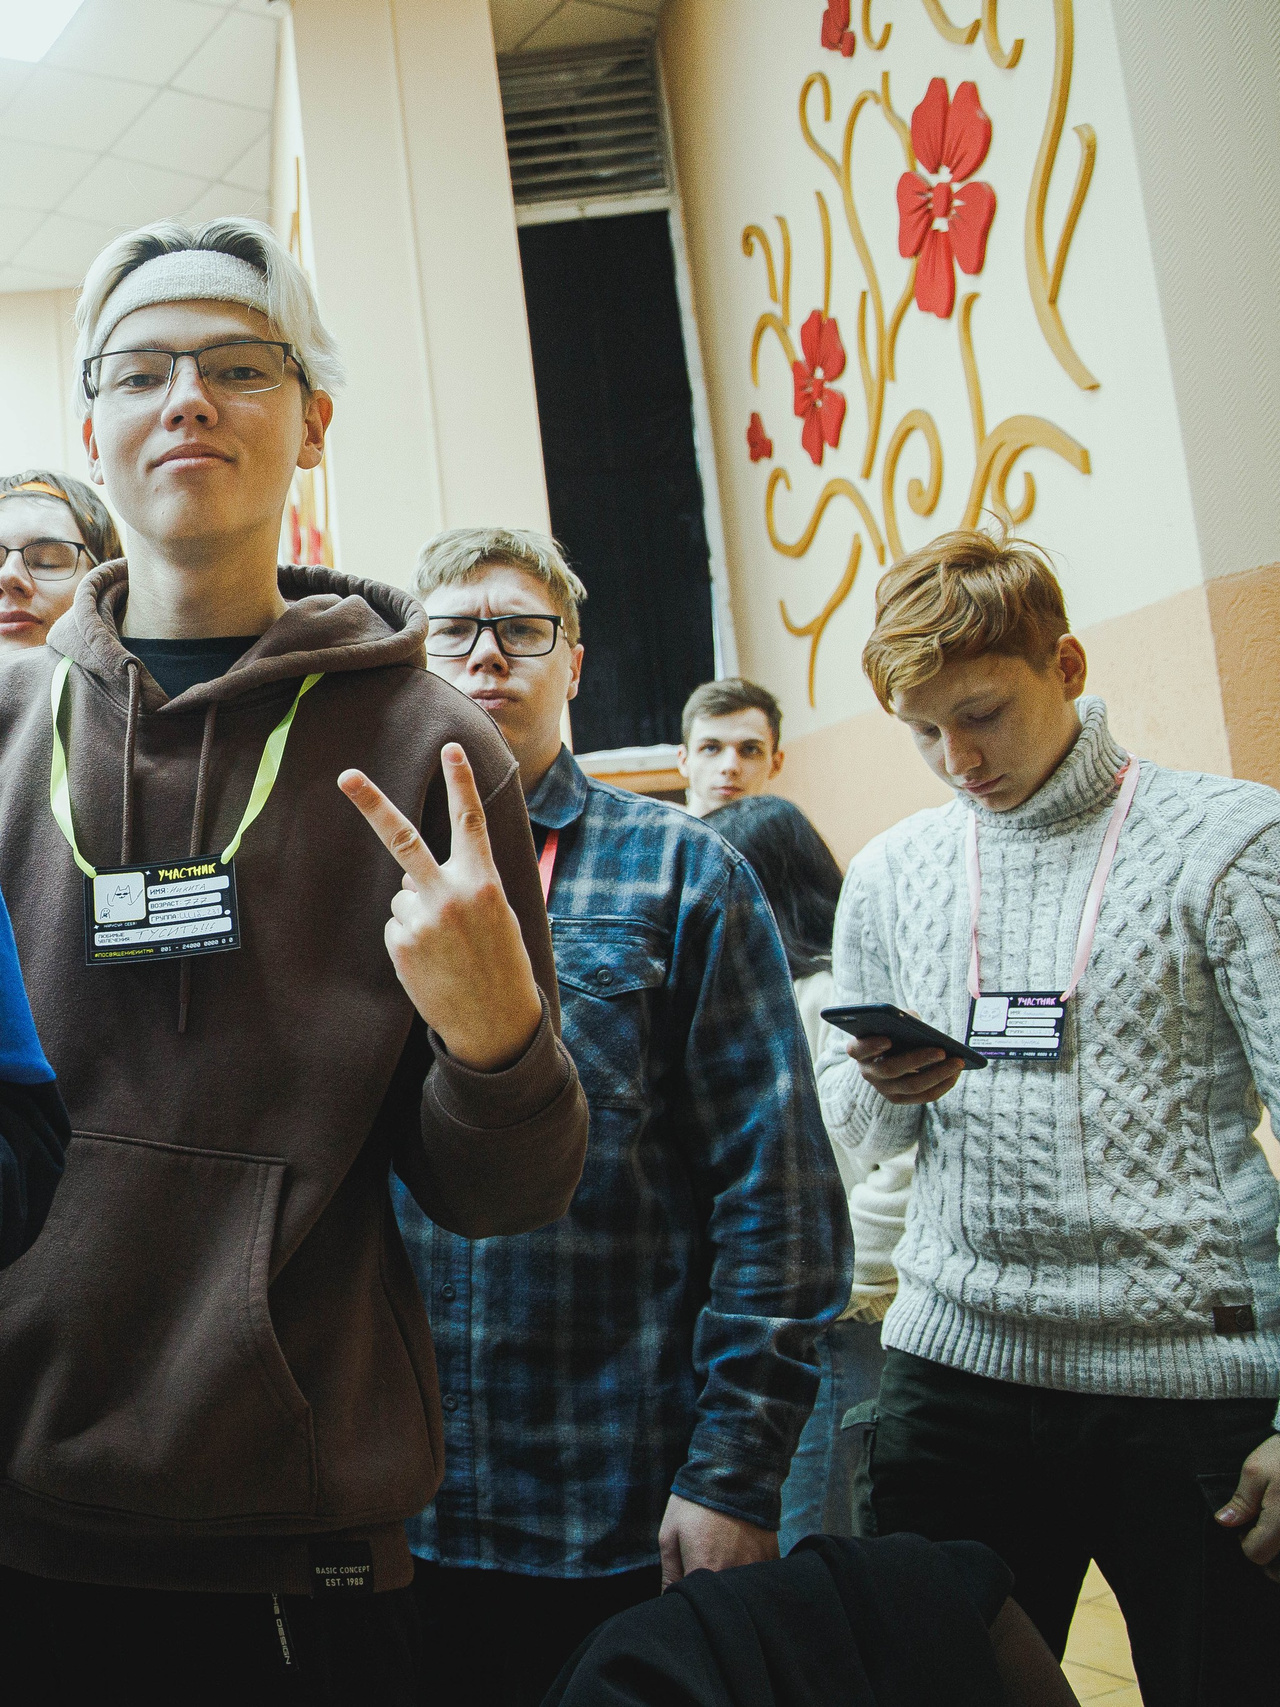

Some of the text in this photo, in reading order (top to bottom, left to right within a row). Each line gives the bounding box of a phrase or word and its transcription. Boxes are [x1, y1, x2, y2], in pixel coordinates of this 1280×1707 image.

[158, 862, 216, 881] УЧАСТНИК
[1017, 997, 1057, 1006] УЧАСТНИК
[315, 1565, 370, 1575] BASIC CONCEPT
[325, 1578, 344, 1586] EST.
[276, 1618, 291, 1665] DESIGN
